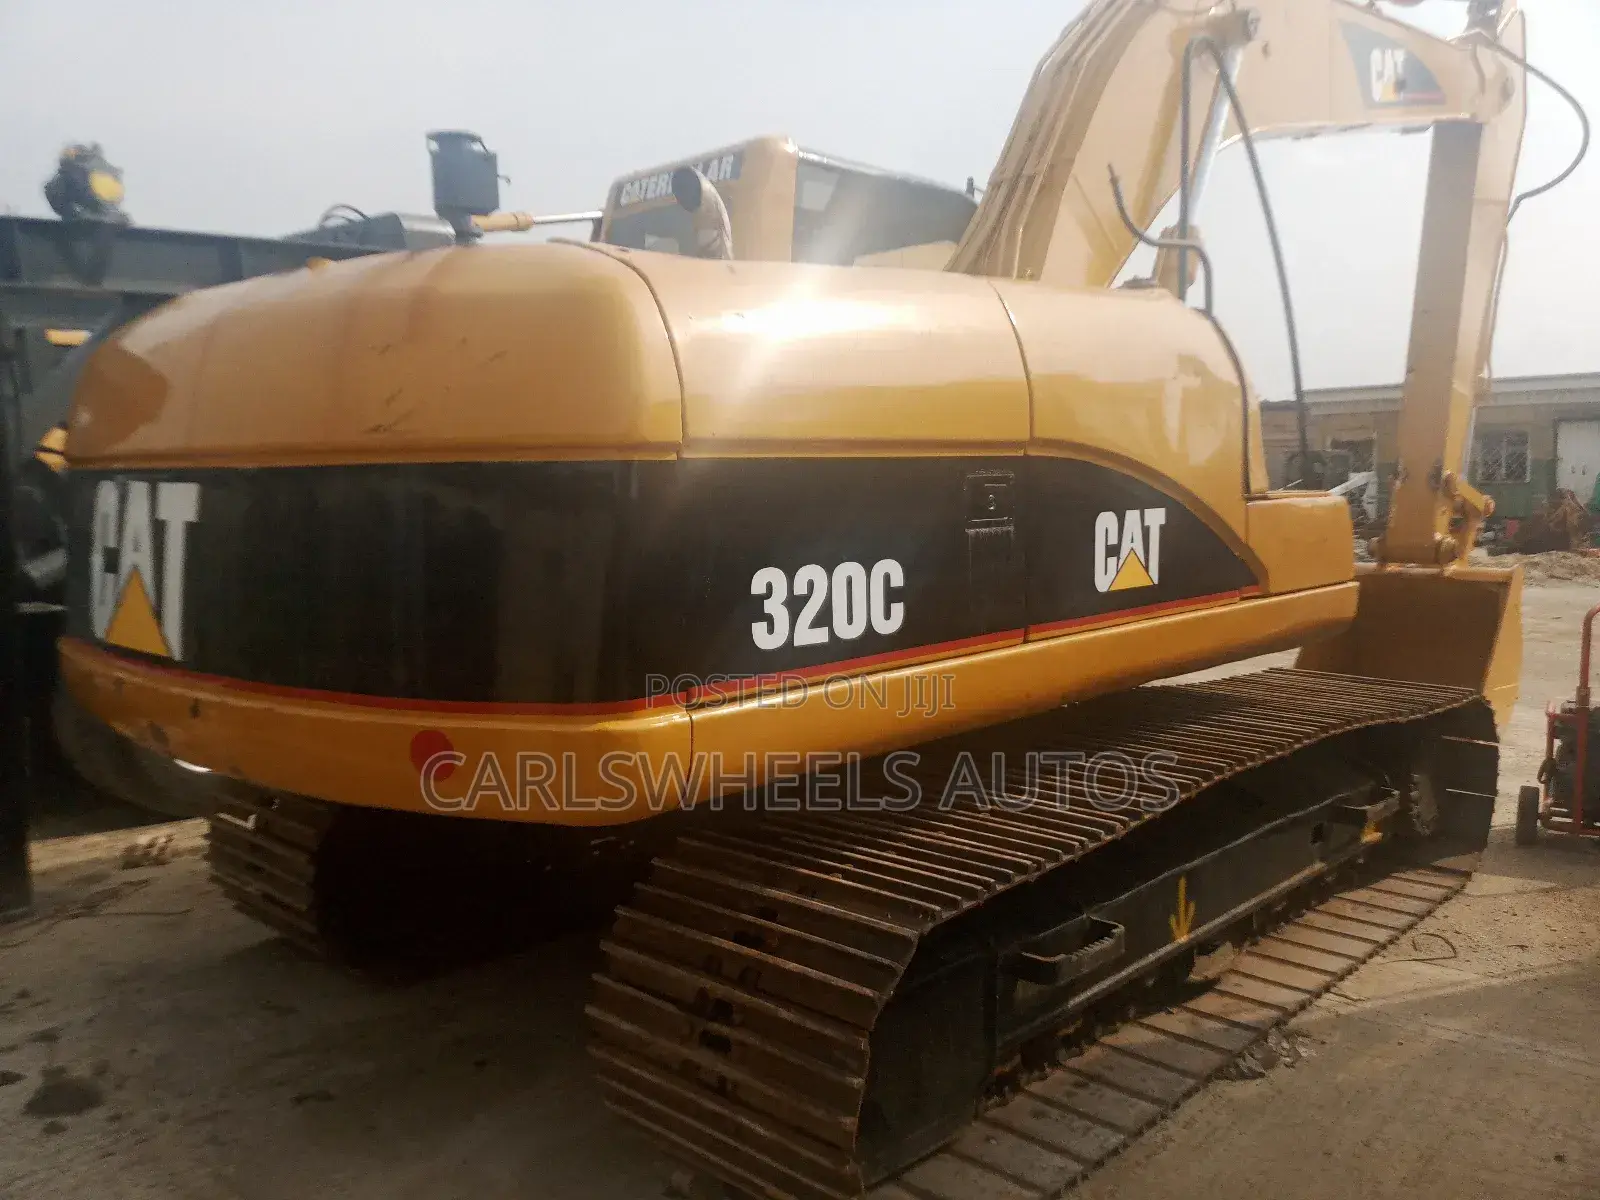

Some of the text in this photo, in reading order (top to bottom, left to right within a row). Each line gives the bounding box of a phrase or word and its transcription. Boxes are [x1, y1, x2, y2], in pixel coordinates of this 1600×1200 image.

[1370, 48, 1406, 102] CAT
[619, 154, 734, 208] CATERAR
[90, 480, 201, 661] CAT
[1094, 507, 1166, 593] CAT
[751, 558, 904, 650] 320C
